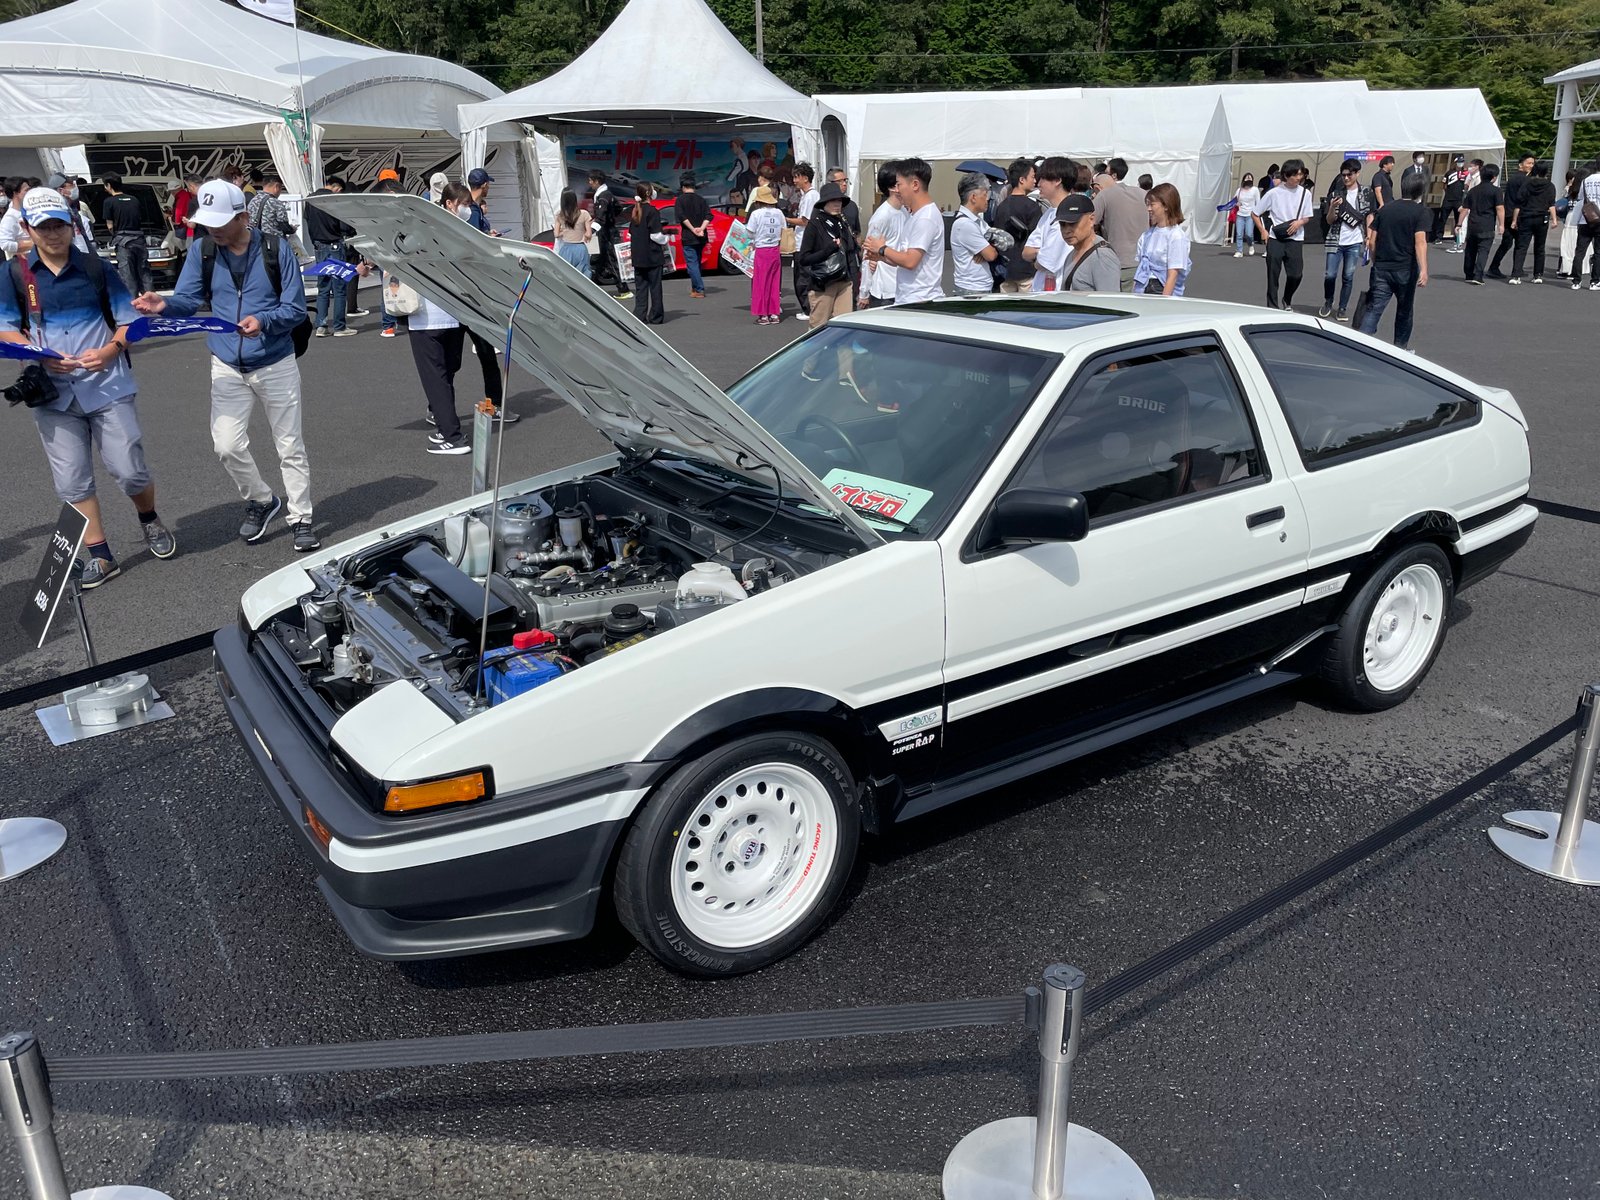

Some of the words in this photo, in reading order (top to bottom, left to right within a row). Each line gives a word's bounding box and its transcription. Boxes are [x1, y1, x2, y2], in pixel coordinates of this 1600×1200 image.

[615, 140, 703, 170] MFゴースト
[1340, 211, 1358, 227] ICON
[28, 284, 37, 306] Canon
[1118, 395, 1168, 414] BRIDE
[570, 588, 626, 601] TOYOTA
[892, 742, 915, 756] SUPER
[915, 734, 935, 748] RAP
[893, 733, 923, 746] POTENZA
[786, 741, 855, 807] POTENZA
[812, 822, 822, 851] RACING
[744, 841, 756, 860] RAP
[803, 852, 817, 877] TUNED
[656, 910, 737, 972] BRIDGESTONE
